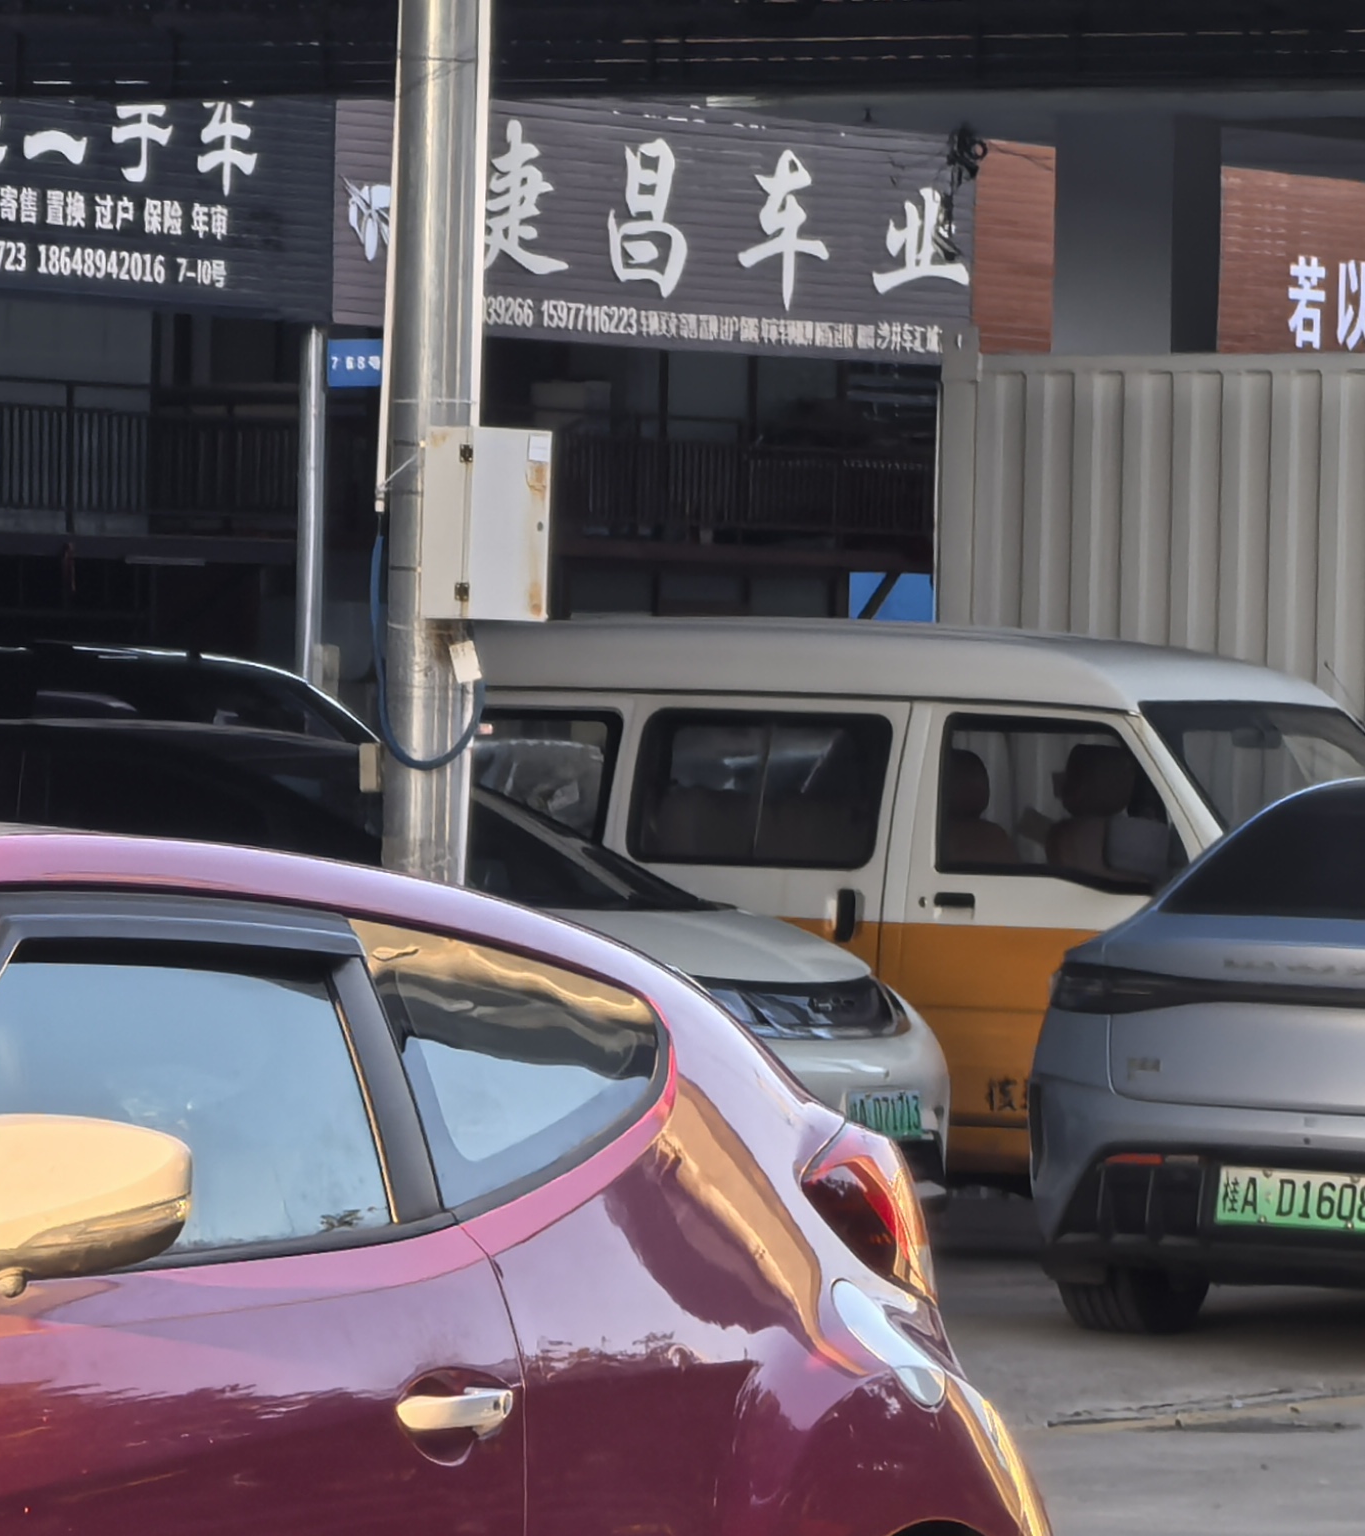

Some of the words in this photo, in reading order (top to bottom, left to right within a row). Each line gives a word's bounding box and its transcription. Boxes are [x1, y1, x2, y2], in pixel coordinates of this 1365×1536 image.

[0, 186, 38, 224] 寄售
[45, 190, 86, 229] 置换
[95, 194, 134, 231] 过户
[144, 198, 182, 236] 保险
[191, 202, 229, 240] 年审
[38, 244, 165, 284] 18648942016
[540, 298, 637, 335] 15977116223
